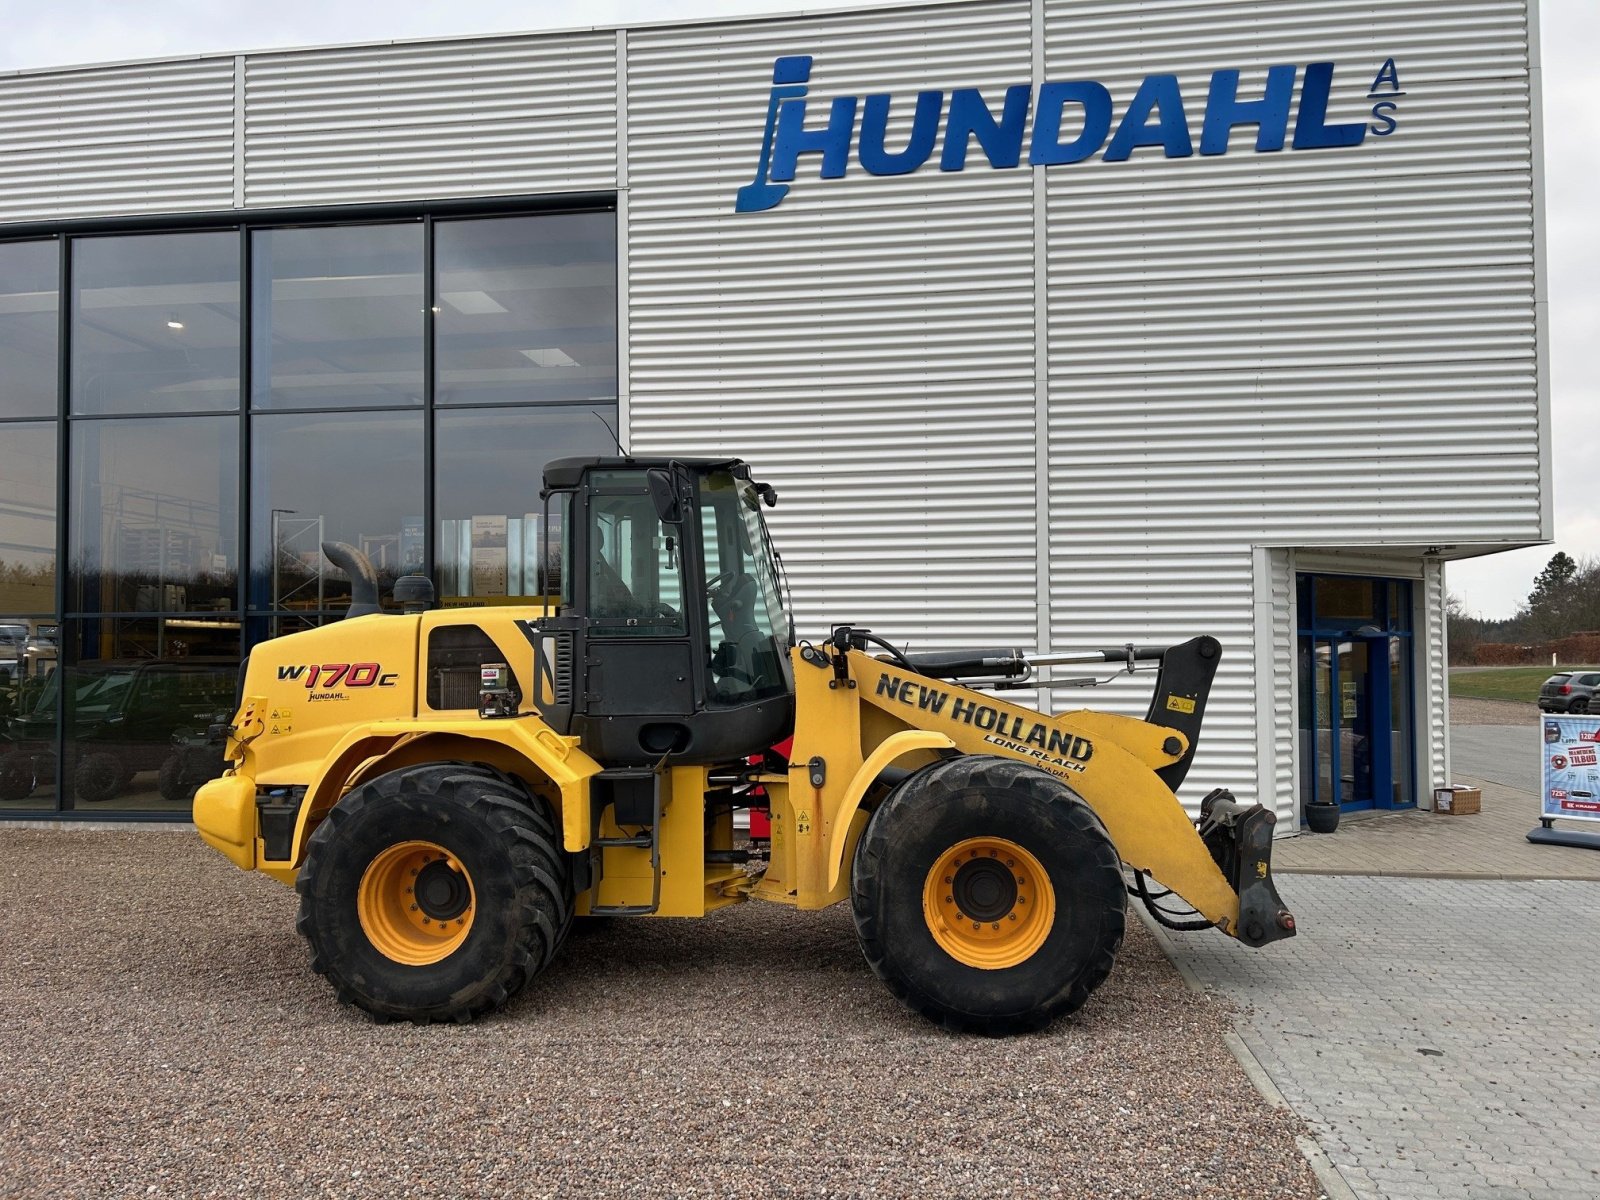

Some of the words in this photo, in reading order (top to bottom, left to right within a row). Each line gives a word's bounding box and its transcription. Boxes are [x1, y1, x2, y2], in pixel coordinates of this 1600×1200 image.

[876, 672, 949, 715] NEW
[951, 696, 1095, 763] HOLLAND
[984, 733, 1028, 757] LONG
[1029, 748, 1087, 774] REACH
[1569, 754, 1597, 764] TILBUD
